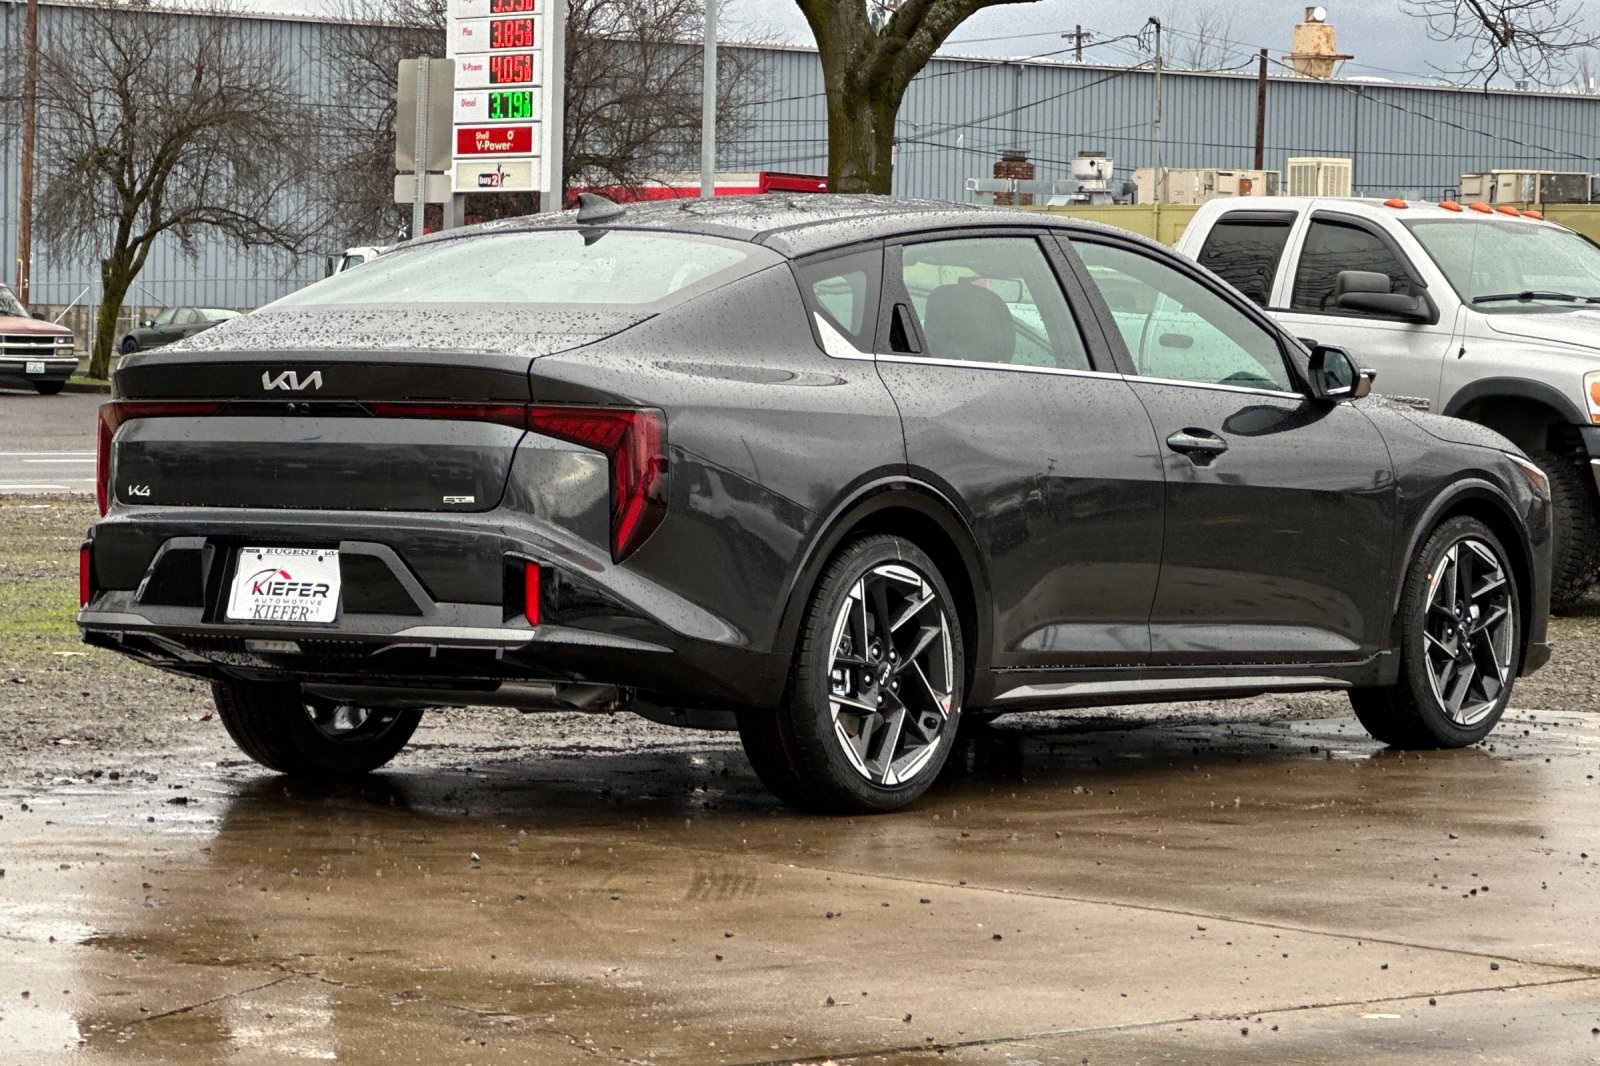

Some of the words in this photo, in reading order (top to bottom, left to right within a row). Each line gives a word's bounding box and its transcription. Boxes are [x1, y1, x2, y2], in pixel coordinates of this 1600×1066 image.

[462, 27, 473, 36] Plus
[462, 63, 483, 72] V-Power
[461, 98, 477, 107] Diesel
[475, 130, 490, 140] Shell
[476, 140, 511, 151] V-Power
[262, 371, 323, 390] KIA
[128, 484, 150, 496] K4
[266, 548, 318, 556] EUGENE
[251, 581, 330, 598] KIEFER
[254, 598, 323, 606] AUTOMOTIVE
[252, 604, 309, 620] KIEFER
